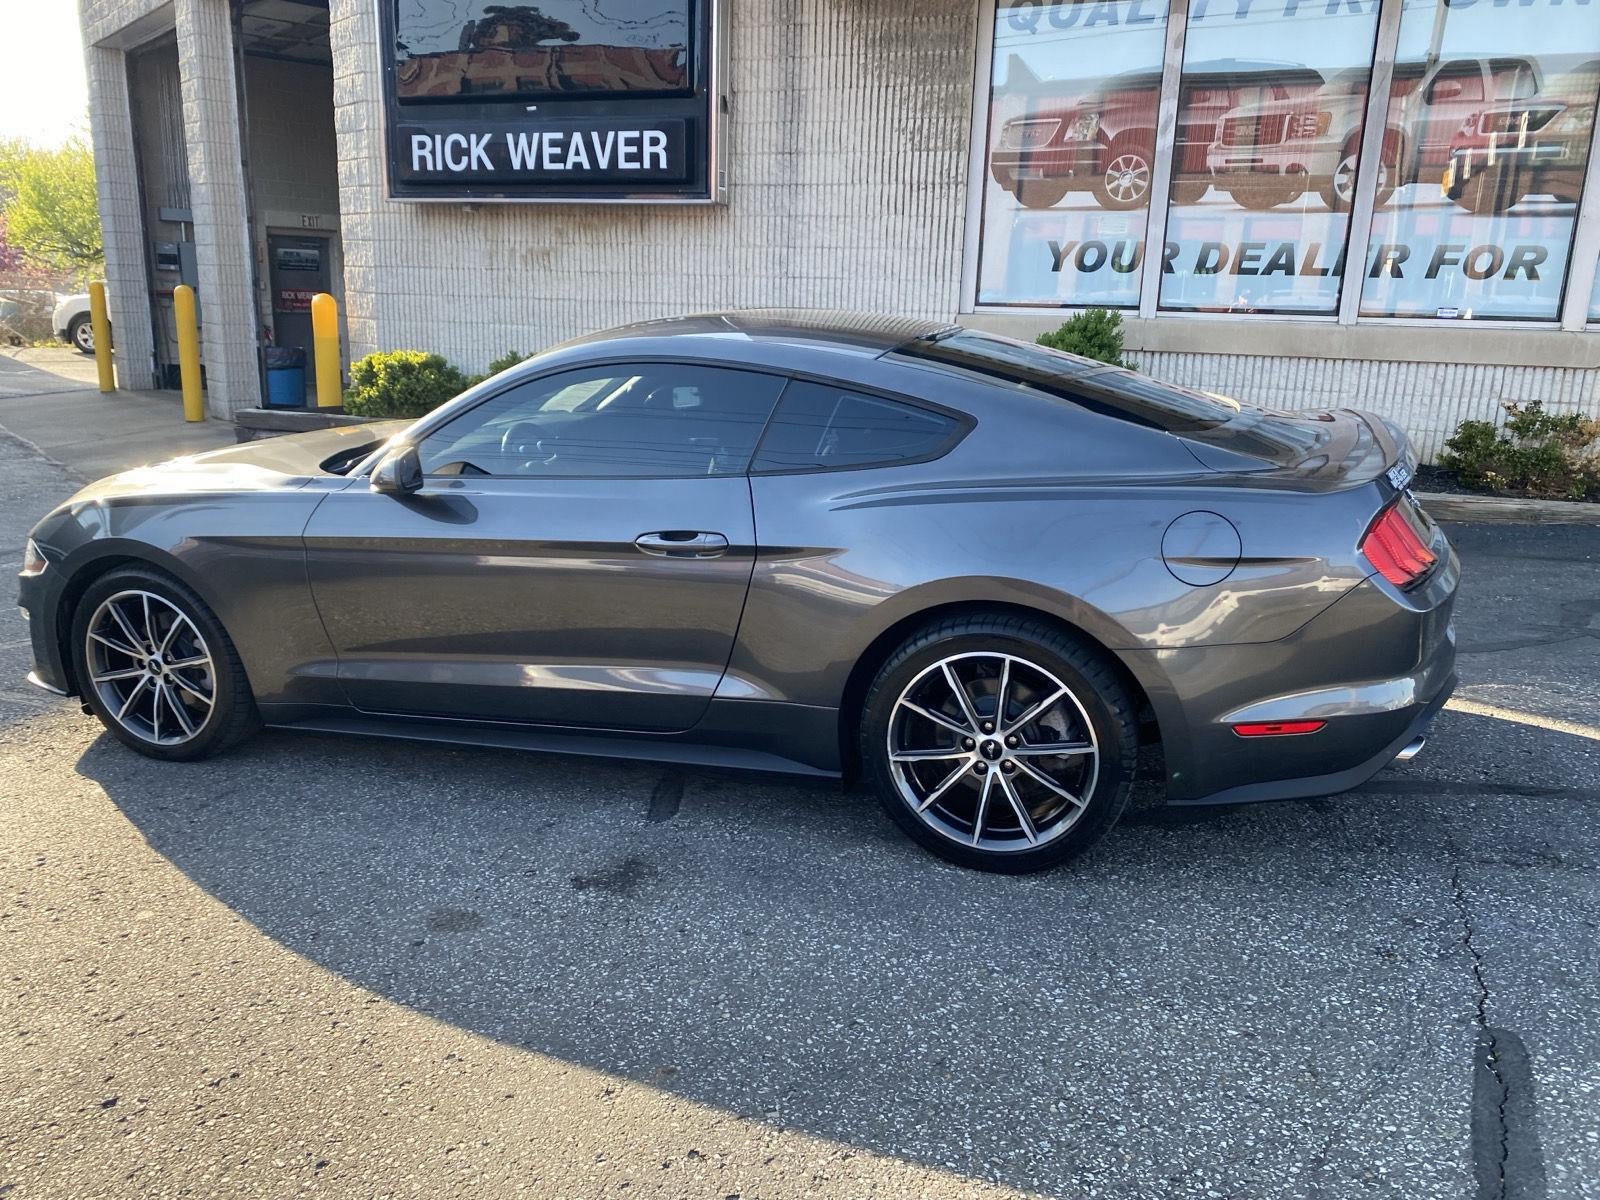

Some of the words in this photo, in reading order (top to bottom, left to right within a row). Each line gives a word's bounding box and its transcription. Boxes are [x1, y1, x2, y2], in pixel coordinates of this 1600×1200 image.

[1007, 0, 1256, 34] QUAL
[411, 133, 494, 171] RICK
[506, 130, 668, 170] WEAVER
[301, 215, 320, 227] EXIT
[1424, 244, 1548, 281] FOR
